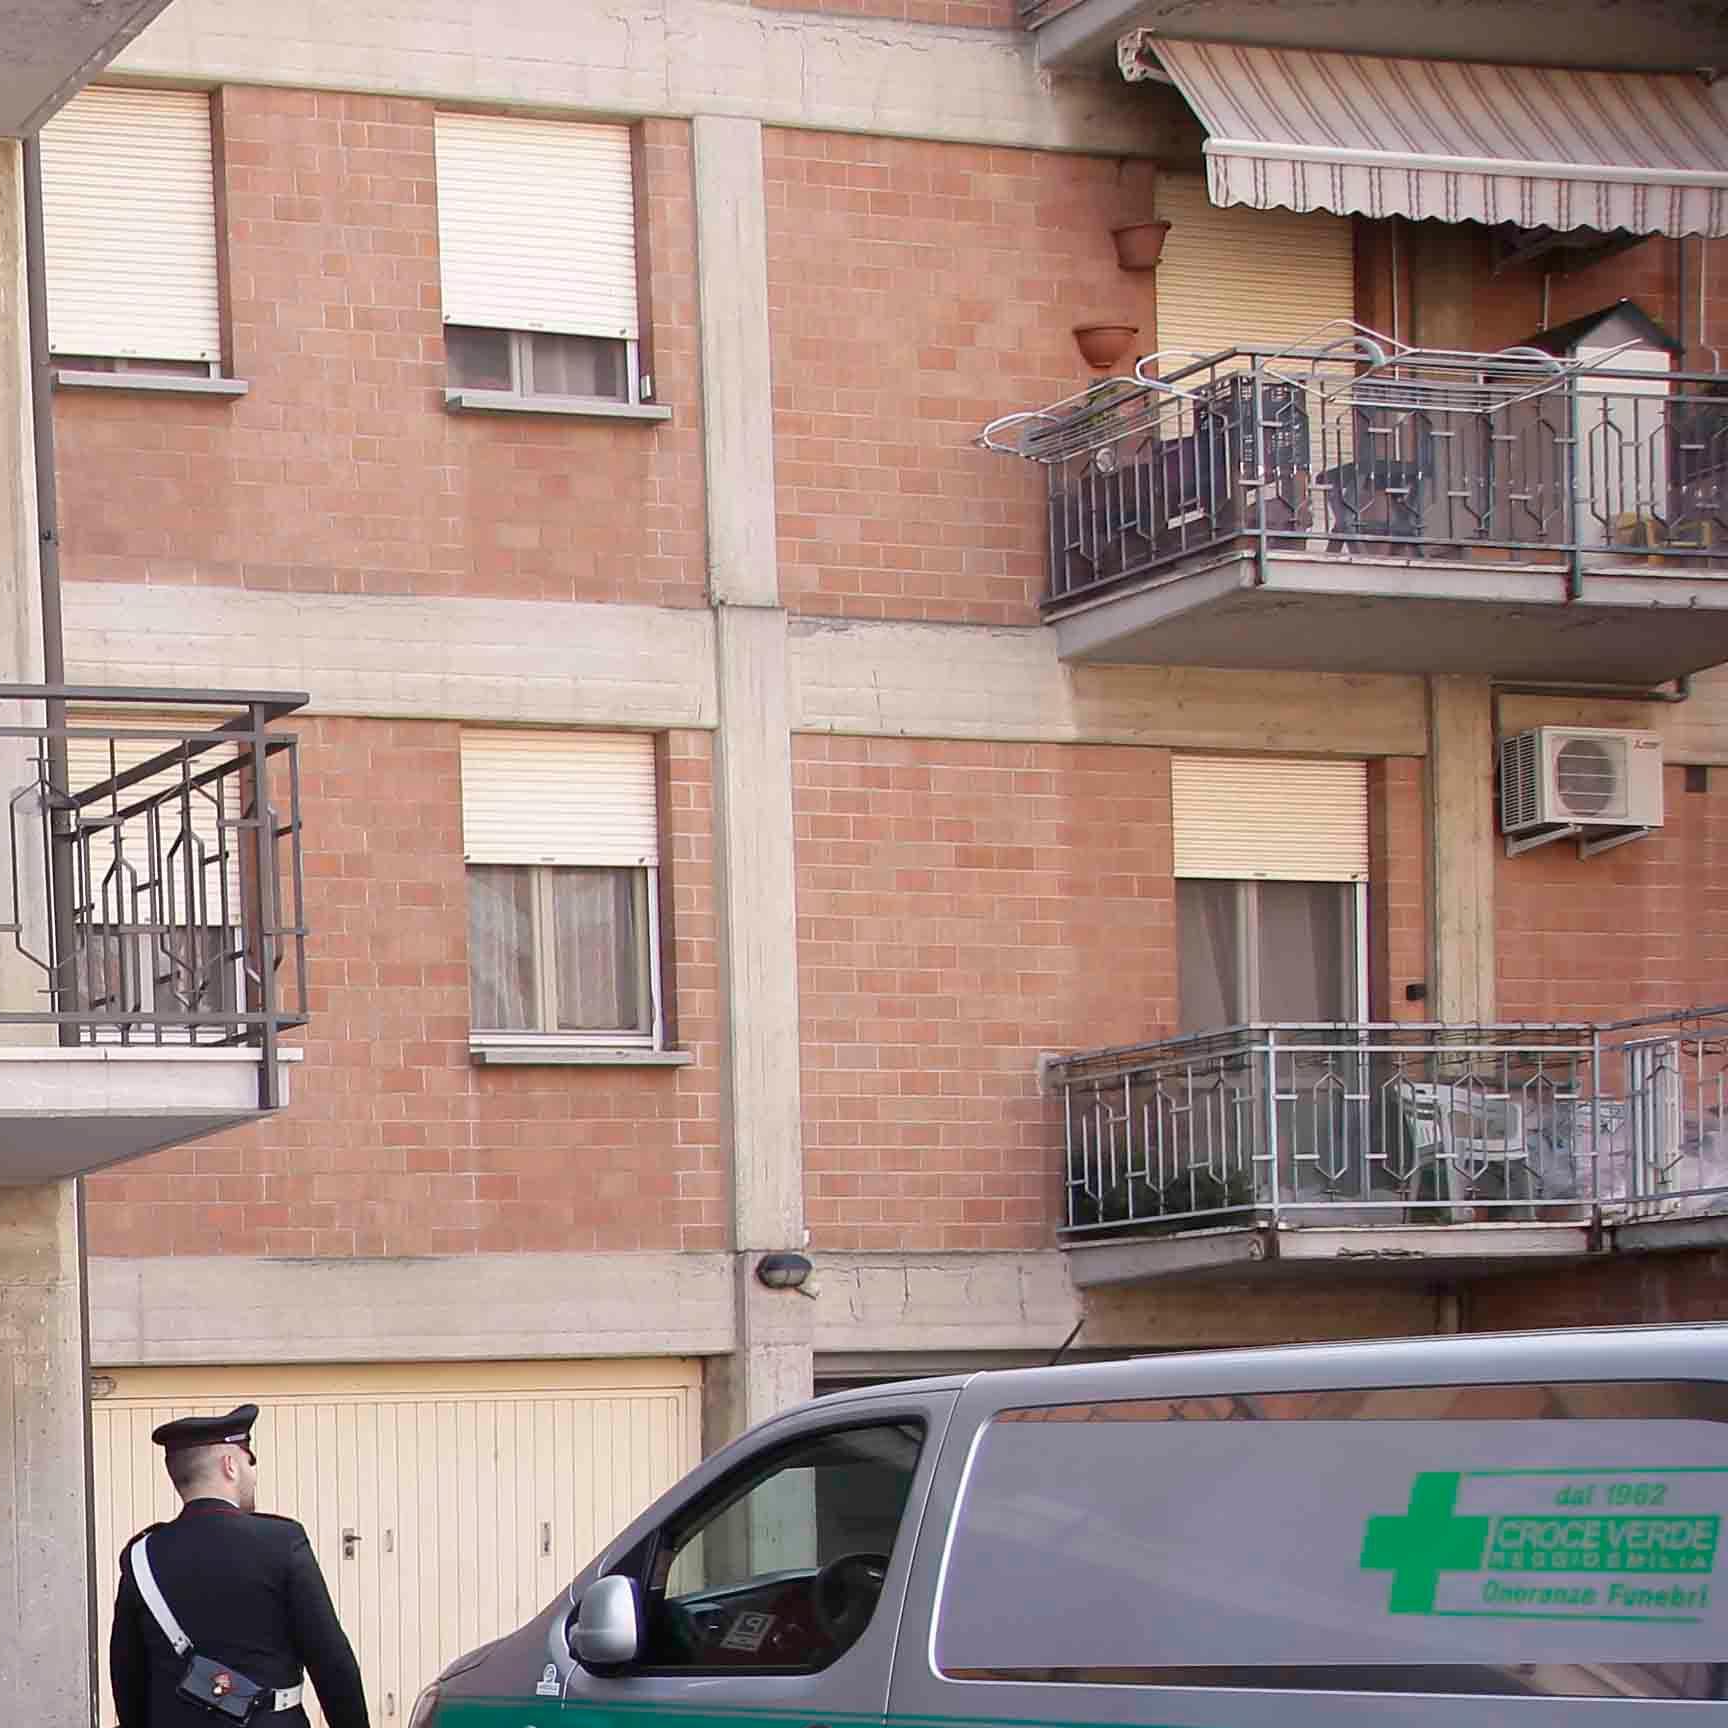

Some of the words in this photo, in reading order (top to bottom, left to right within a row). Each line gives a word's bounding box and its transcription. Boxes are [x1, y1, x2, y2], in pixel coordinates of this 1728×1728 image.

[1499, 1519, 1601, 1550] CROCE
[1607, 1519, 1713, 1550] VERDE
[1482, 1580, 1598, 1605] Onoranze
[1607, 1583, 1709, 1608] Funebri
